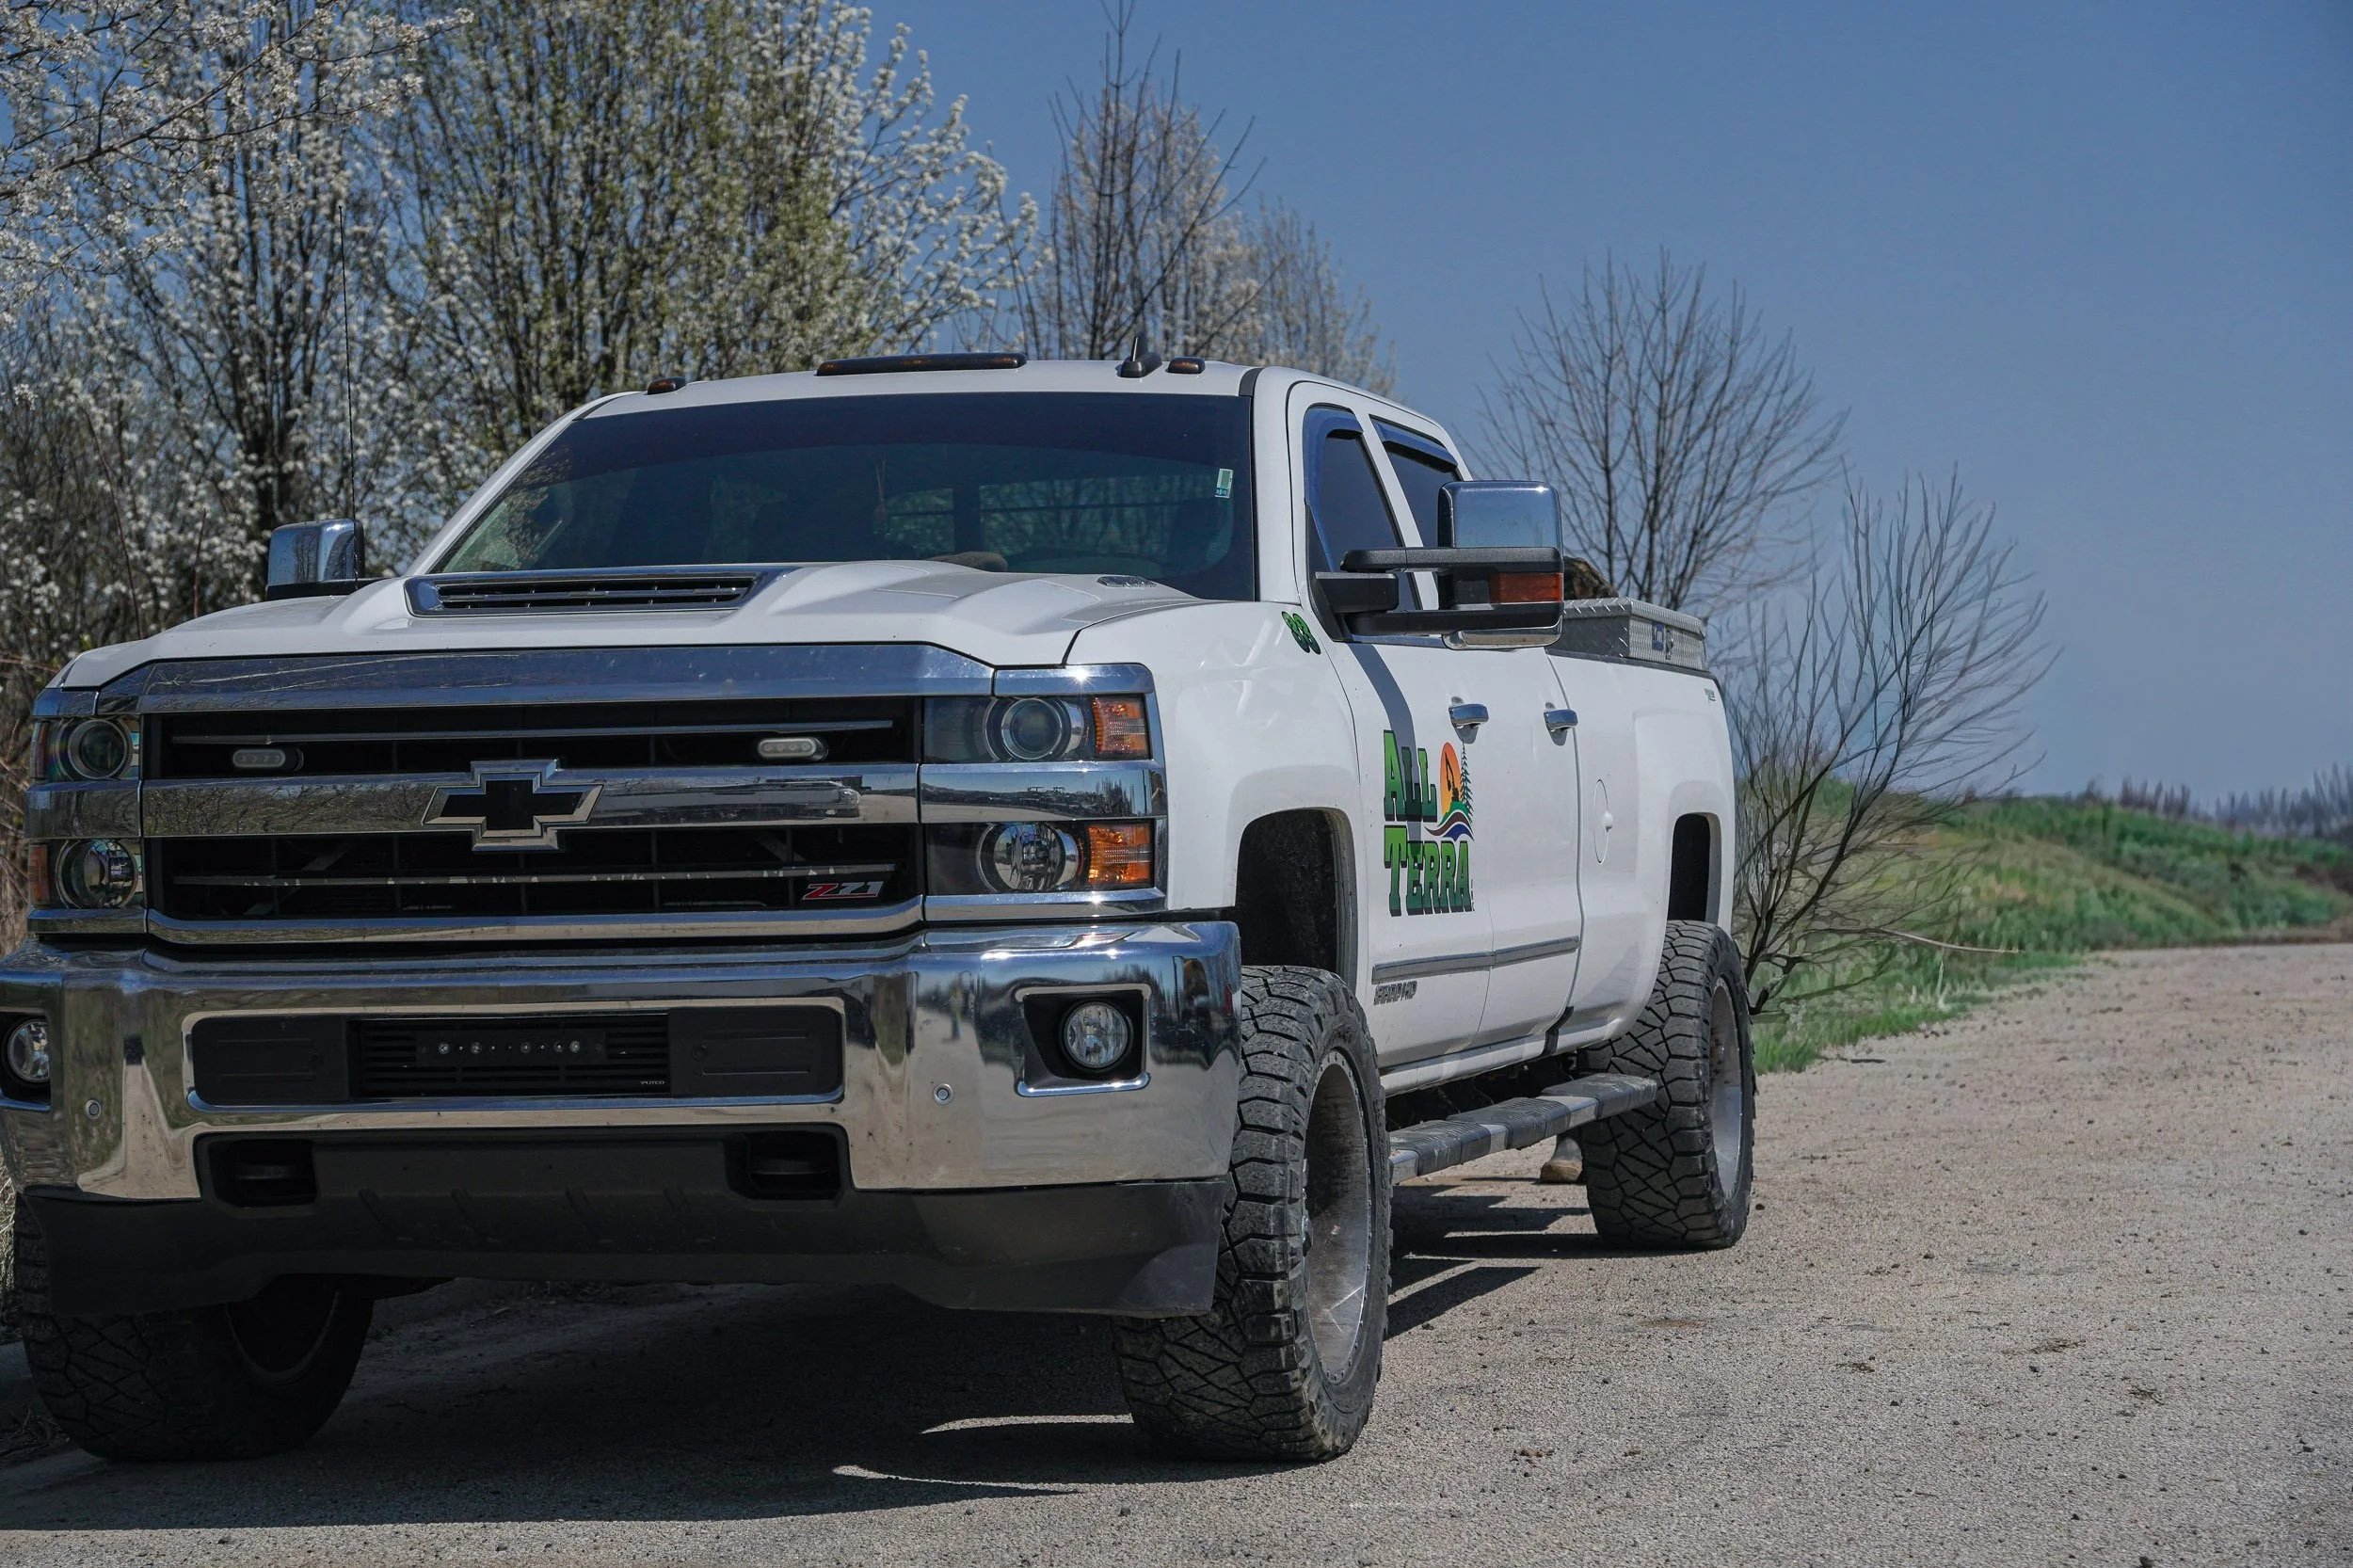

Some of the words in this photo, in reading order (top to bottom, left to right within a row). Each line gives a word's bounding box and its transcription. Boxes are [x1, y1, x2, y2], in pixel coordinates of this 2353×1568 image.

[1383, 729, 1437, 822] ALL
[803, 881, 884, 900] Z71
[1384, 824, 1472, 917] TERRA
